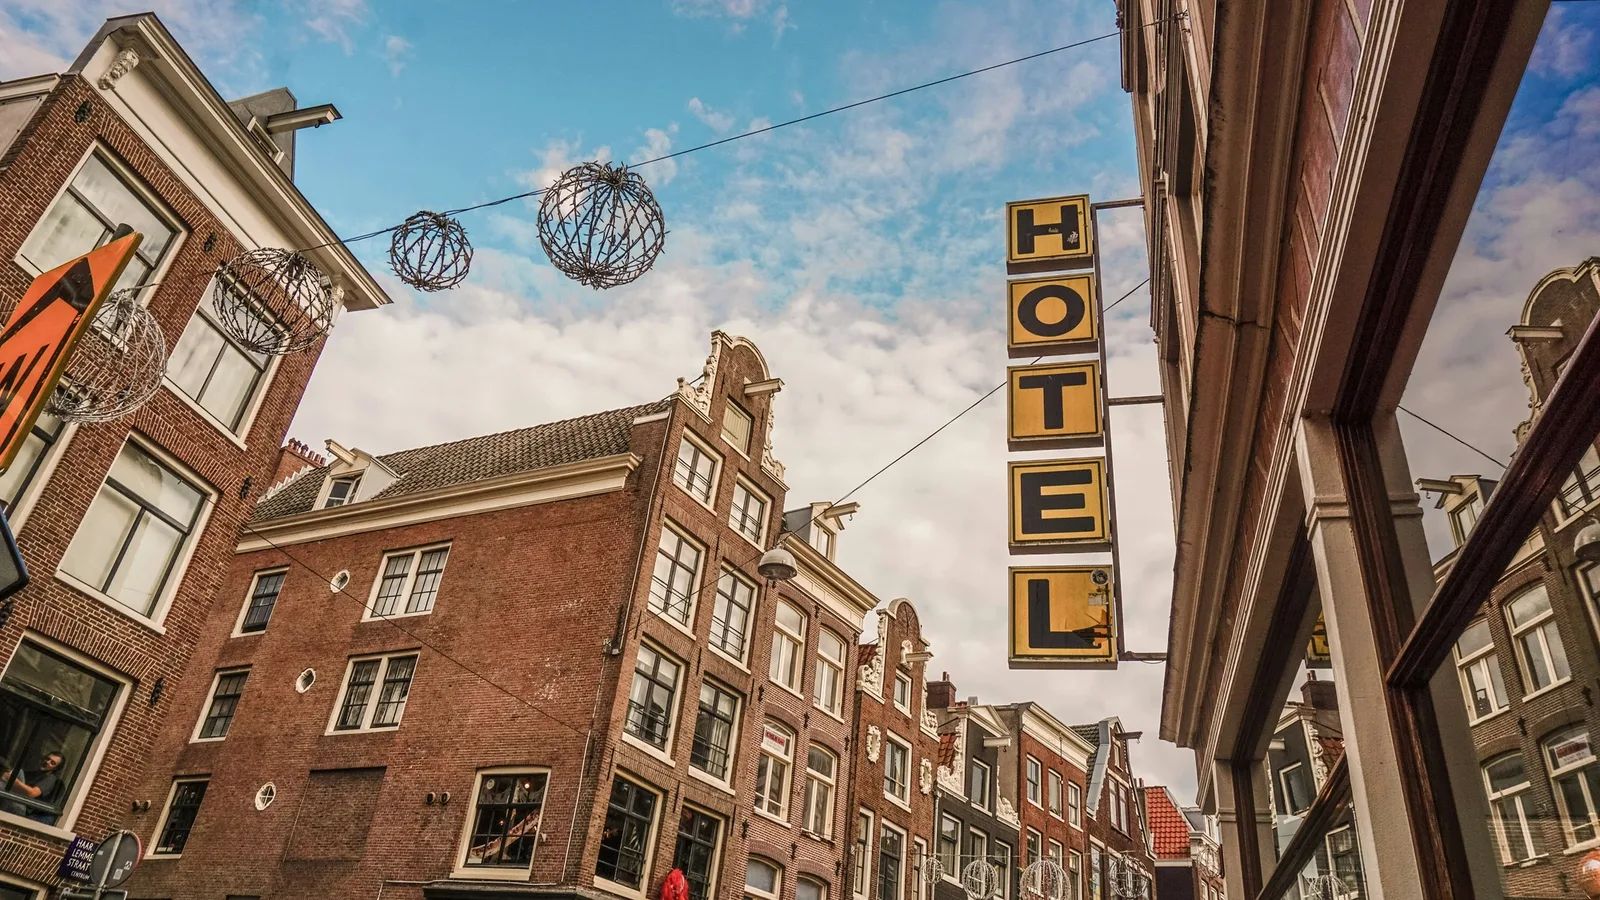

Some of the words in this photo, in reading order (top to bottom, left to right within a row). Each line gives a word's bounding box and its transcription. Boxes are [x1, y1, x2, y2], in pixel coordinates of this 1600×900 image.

[1016, 203, 1102, 650] HOTEL
[76, 839, 94, 851] HAAR
[71, 848, 94, 862] LEMME
[66, 857, 91, 871] STRAAT
[70, 870, 90, 880] CENTRUM
